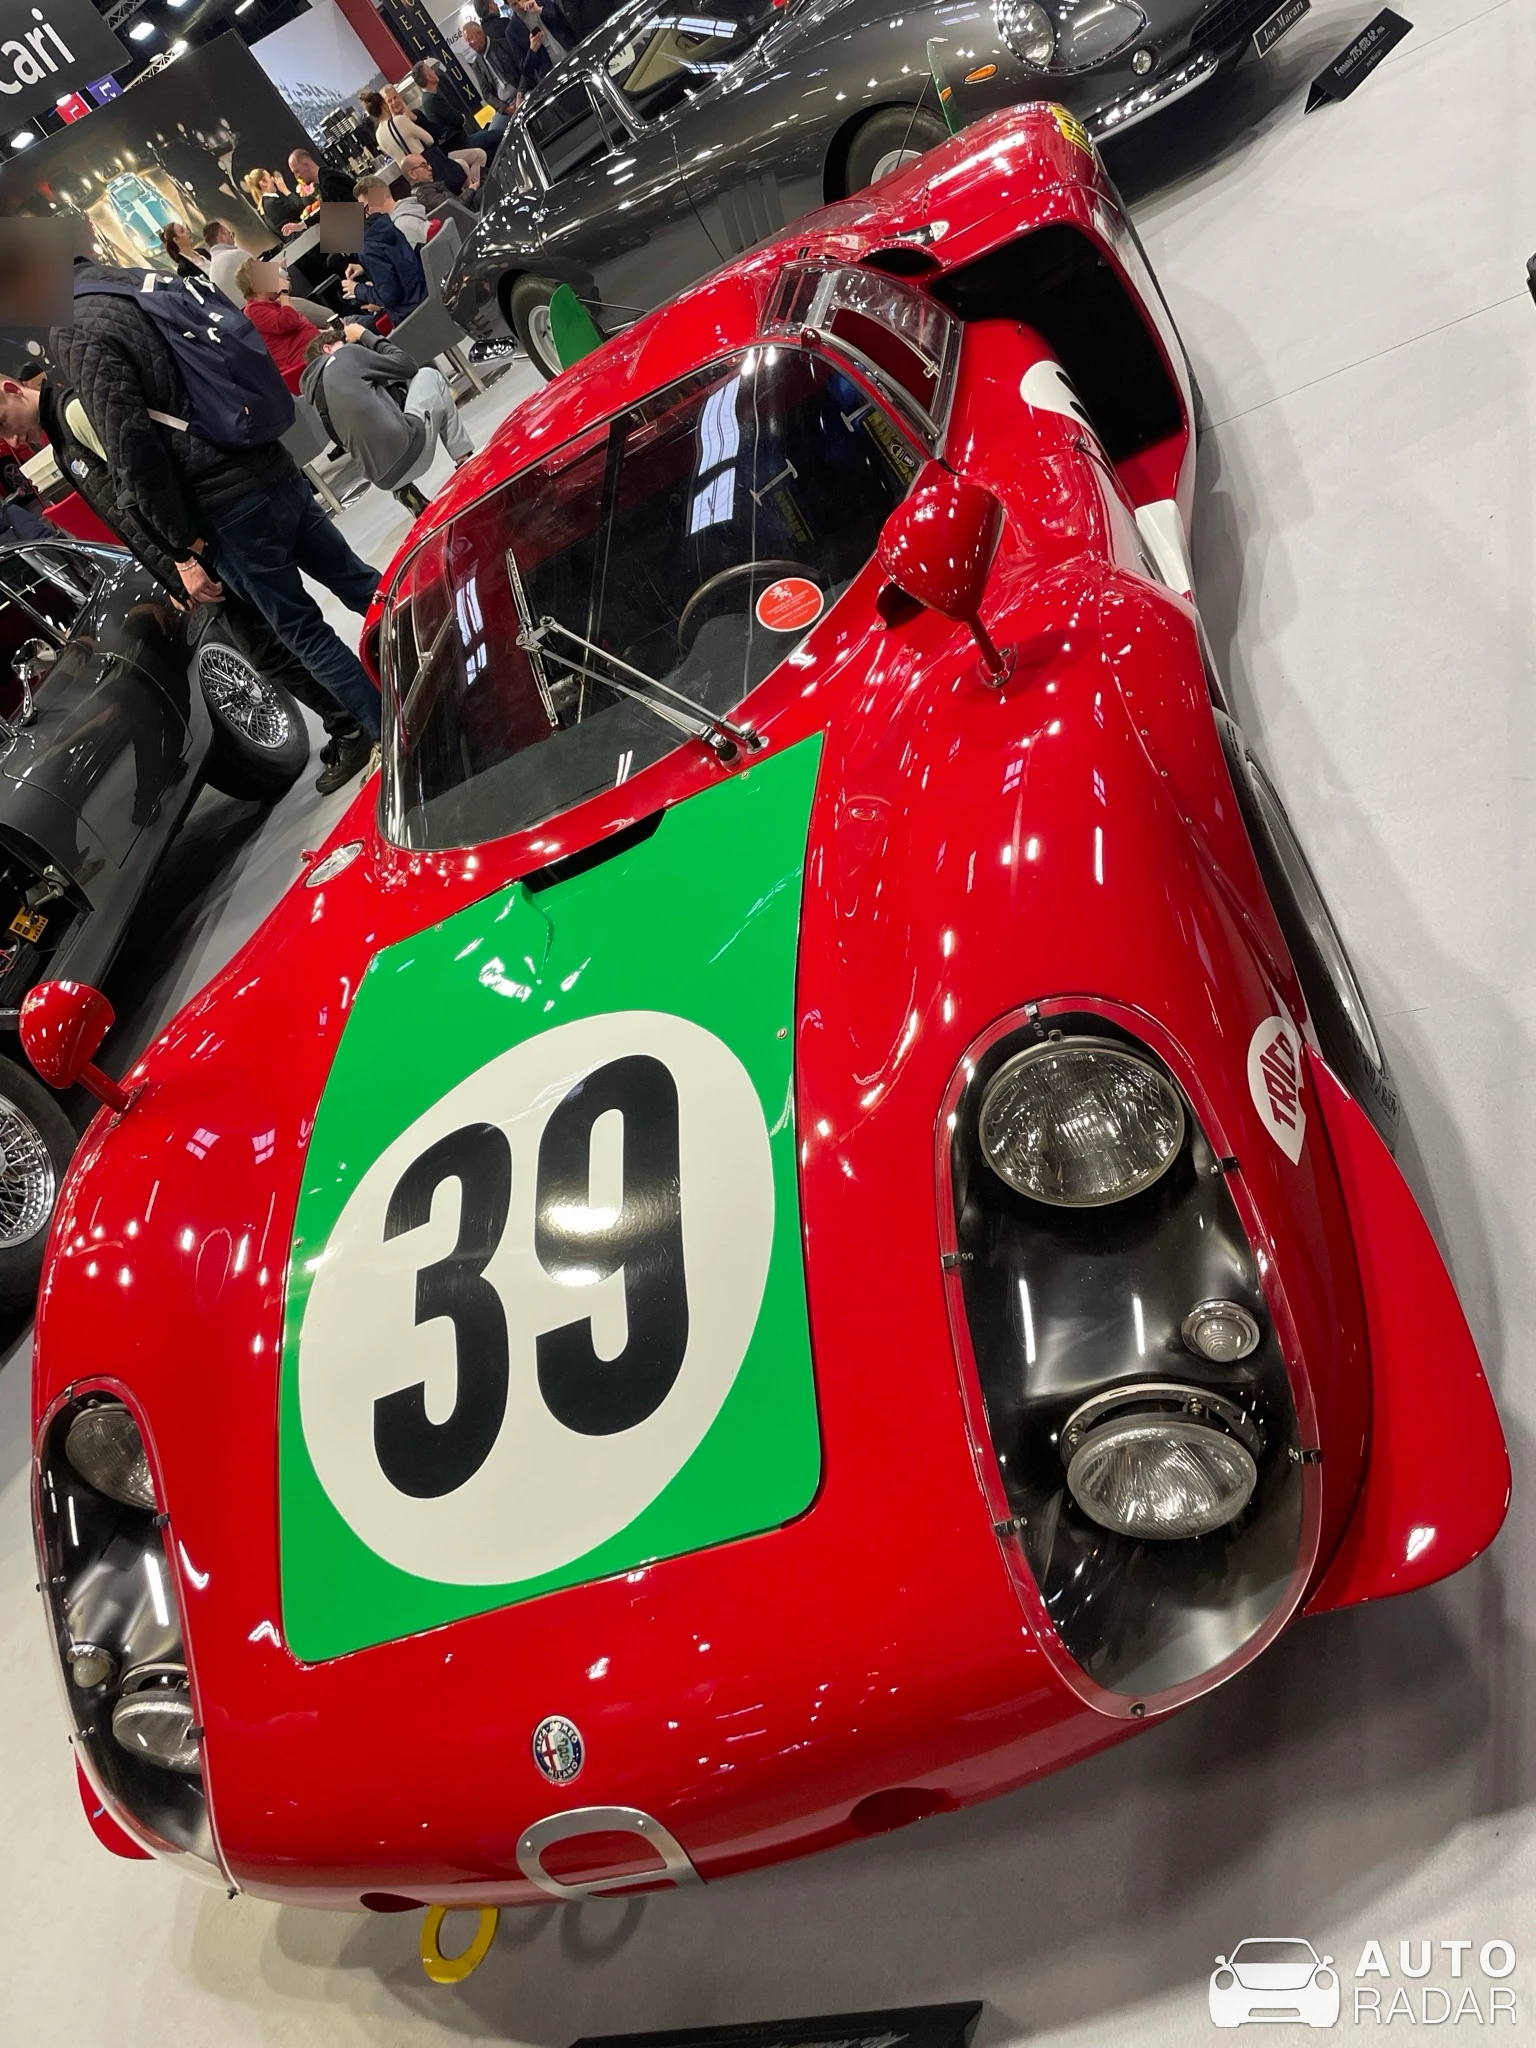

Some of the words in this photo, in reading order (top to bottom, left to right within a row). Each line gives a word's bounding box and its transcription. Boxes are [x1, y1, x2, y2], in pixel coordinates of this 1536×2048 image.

[1262, 26, 1278, 45] Joe
[1276, 0, 1304, 31] Macari
[1259, 1030, 1304, 1133] TRICO
[373, 1054, 690, 1499] 39
[547, 1761, 578, 1779] MILANO
